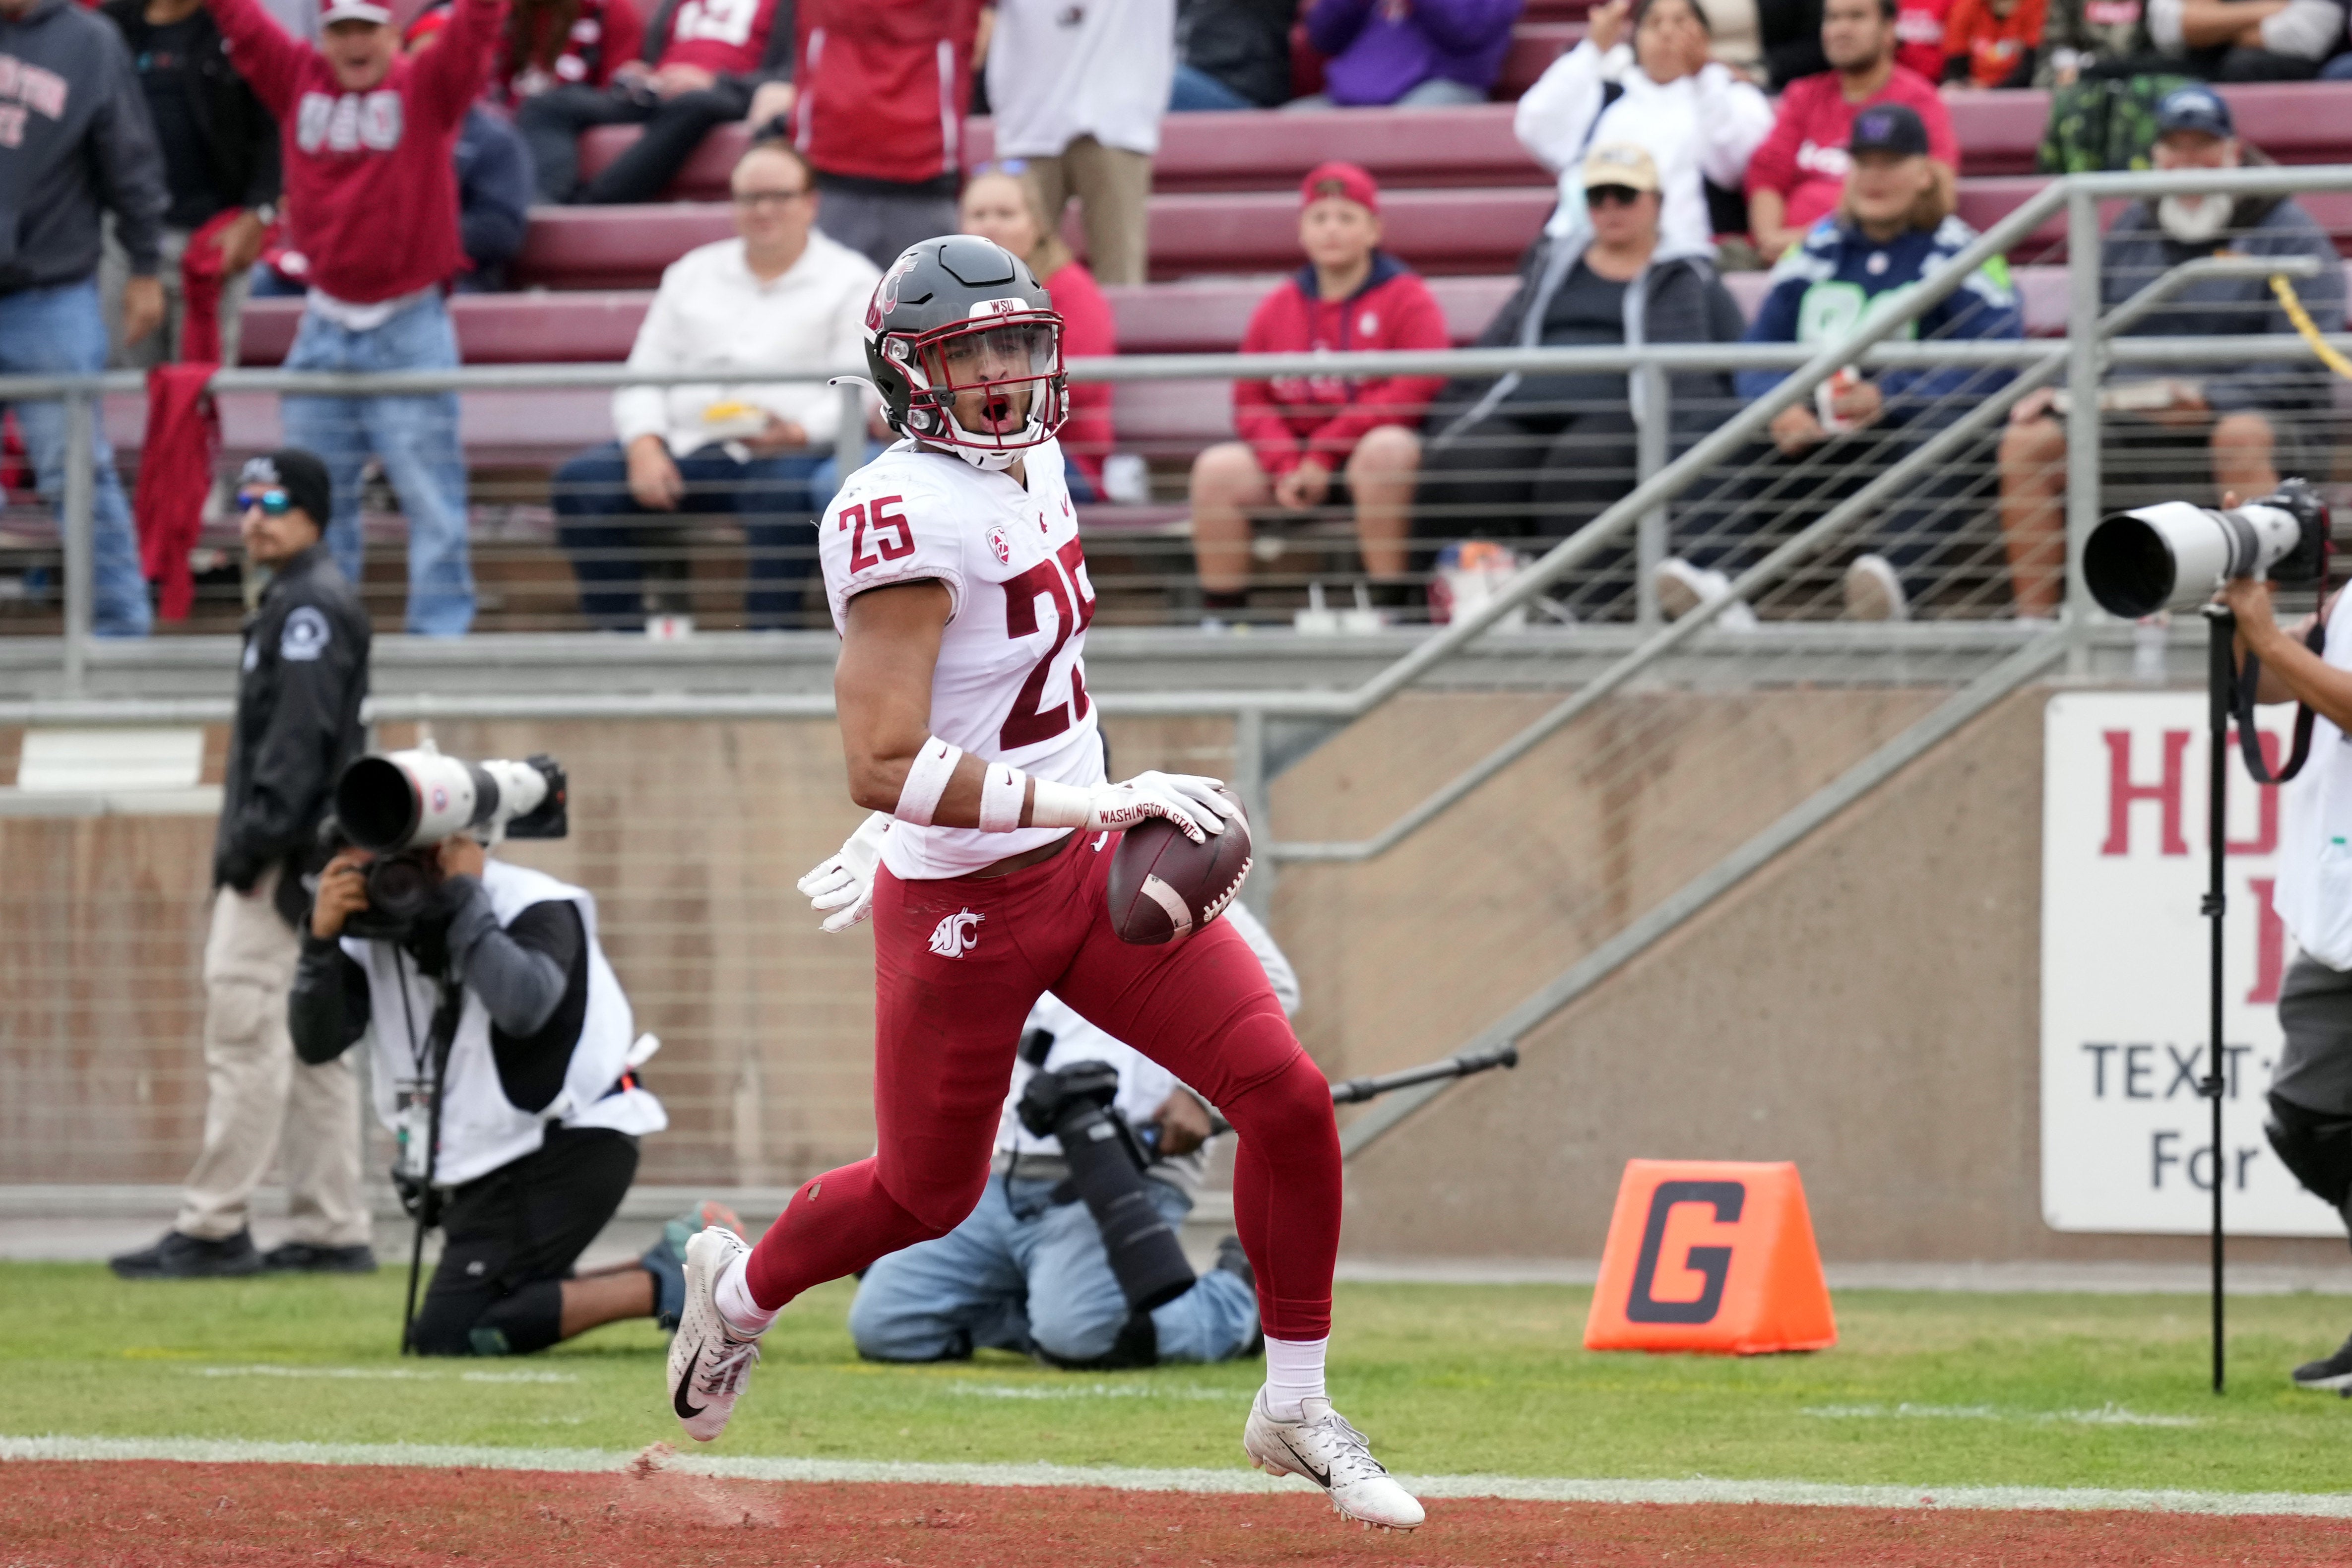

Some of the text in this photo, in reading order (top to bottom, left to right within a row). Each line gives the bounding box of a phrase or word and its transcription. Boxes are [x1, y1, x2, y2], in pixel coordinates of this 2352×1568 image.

[990, 299, 1014, 313] WSU
[838, 495, 915, 574] 25
[1099, 802, 1199, 839] WASHINGTON STATE
[2152, 1131, 2260, 1190] For
[1625, 1180, 1746, 1325] G
